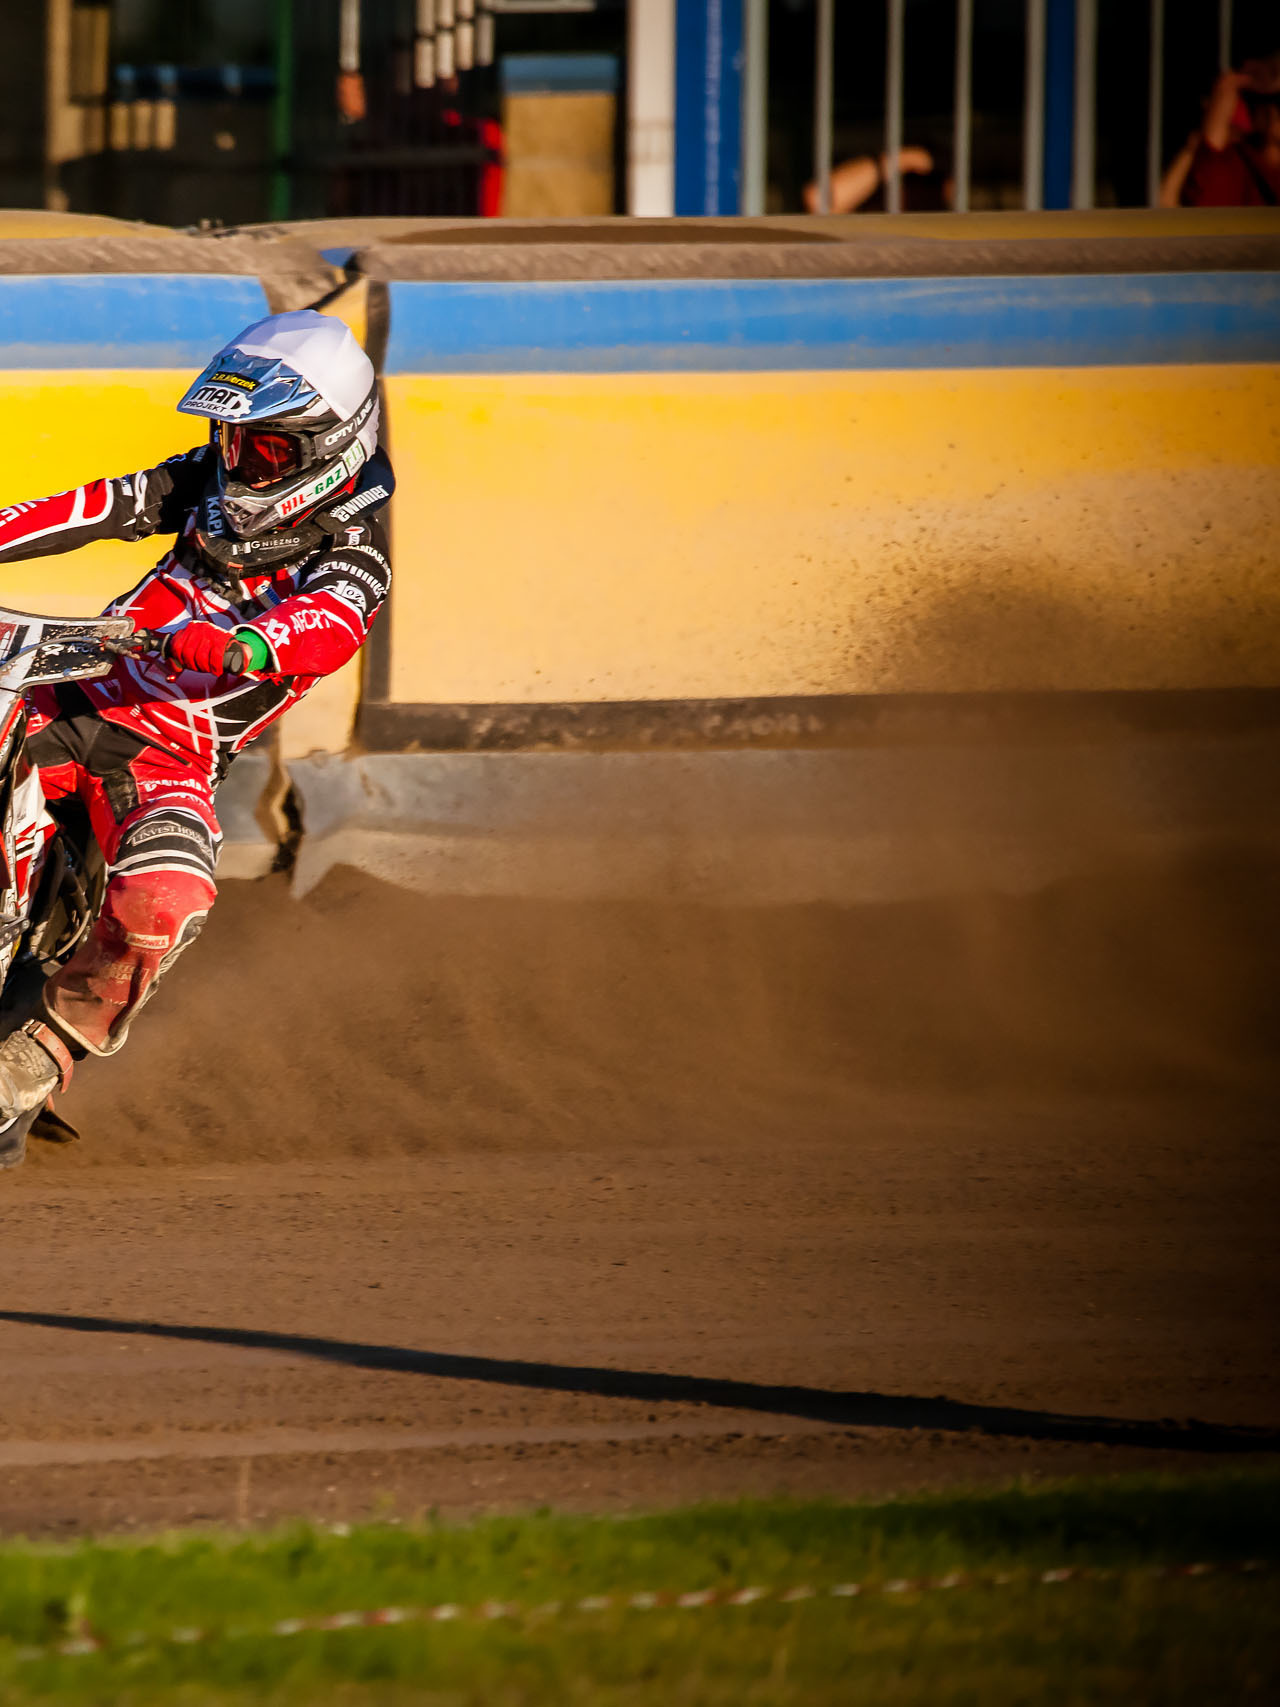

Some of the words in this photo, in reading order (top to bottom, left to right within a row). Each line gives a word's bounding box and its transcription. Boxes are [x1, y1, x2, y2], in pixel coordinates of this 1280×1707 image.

[184, 400, 227, 413] PROJEKT
[280, 468, 342, 515] HIL-GAZ
[336, 484, 390, 522] ewinner
[251, 537, 300, 549] GNIEZNO
